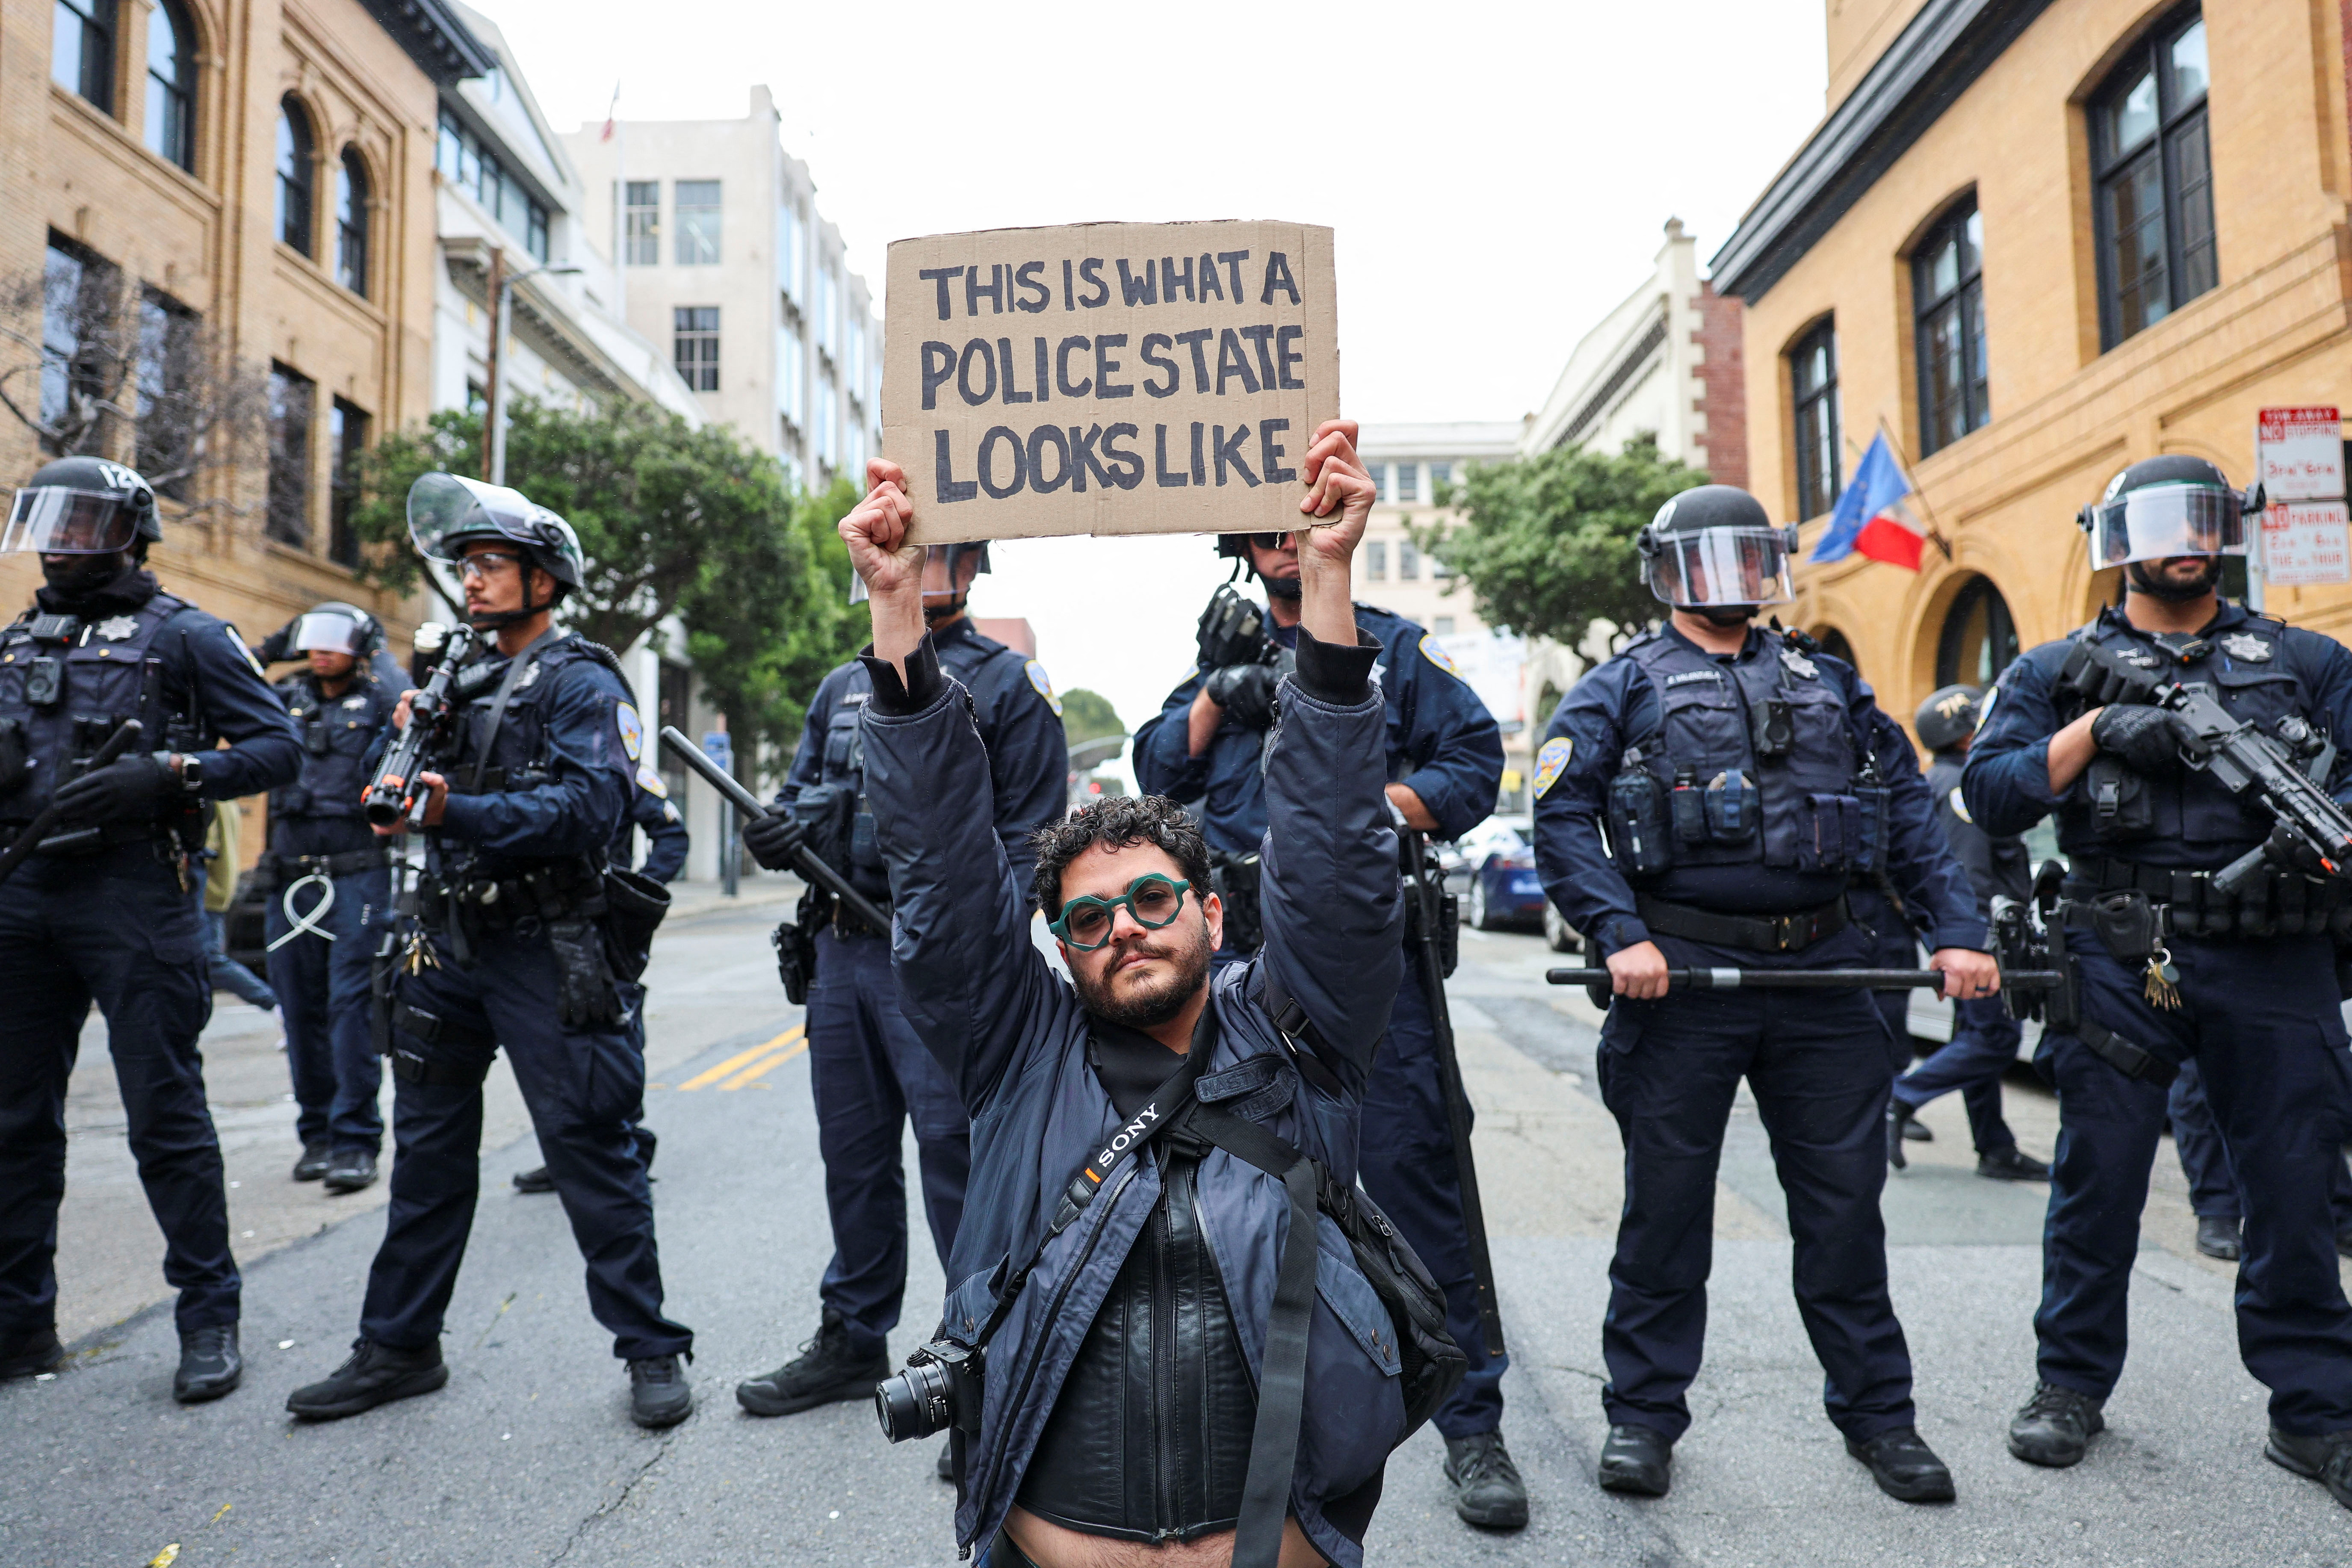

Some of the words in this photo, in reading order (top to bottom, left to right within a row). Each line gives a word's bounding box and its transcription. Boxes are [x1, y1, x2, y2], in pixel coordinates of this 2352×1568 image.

[919, 261, 1050, 320] THIS
[1063, 258, 1110, 311] IS
[1116, 250, 1249, 307] WHAT
[1261, 251, 1301, 306] A
[921, 334, 1134, 410] POLICE
[1141, 324, 1305, 399] STATE
[935, 422, 1144, 504] LOOKS
[1155, 418, 1297, 488] LIKE
[2261, 421, 2283, 439] NO
[2263, 508, 2288, 526] NO
[1099, 1103, 1159, 1167] SONY
